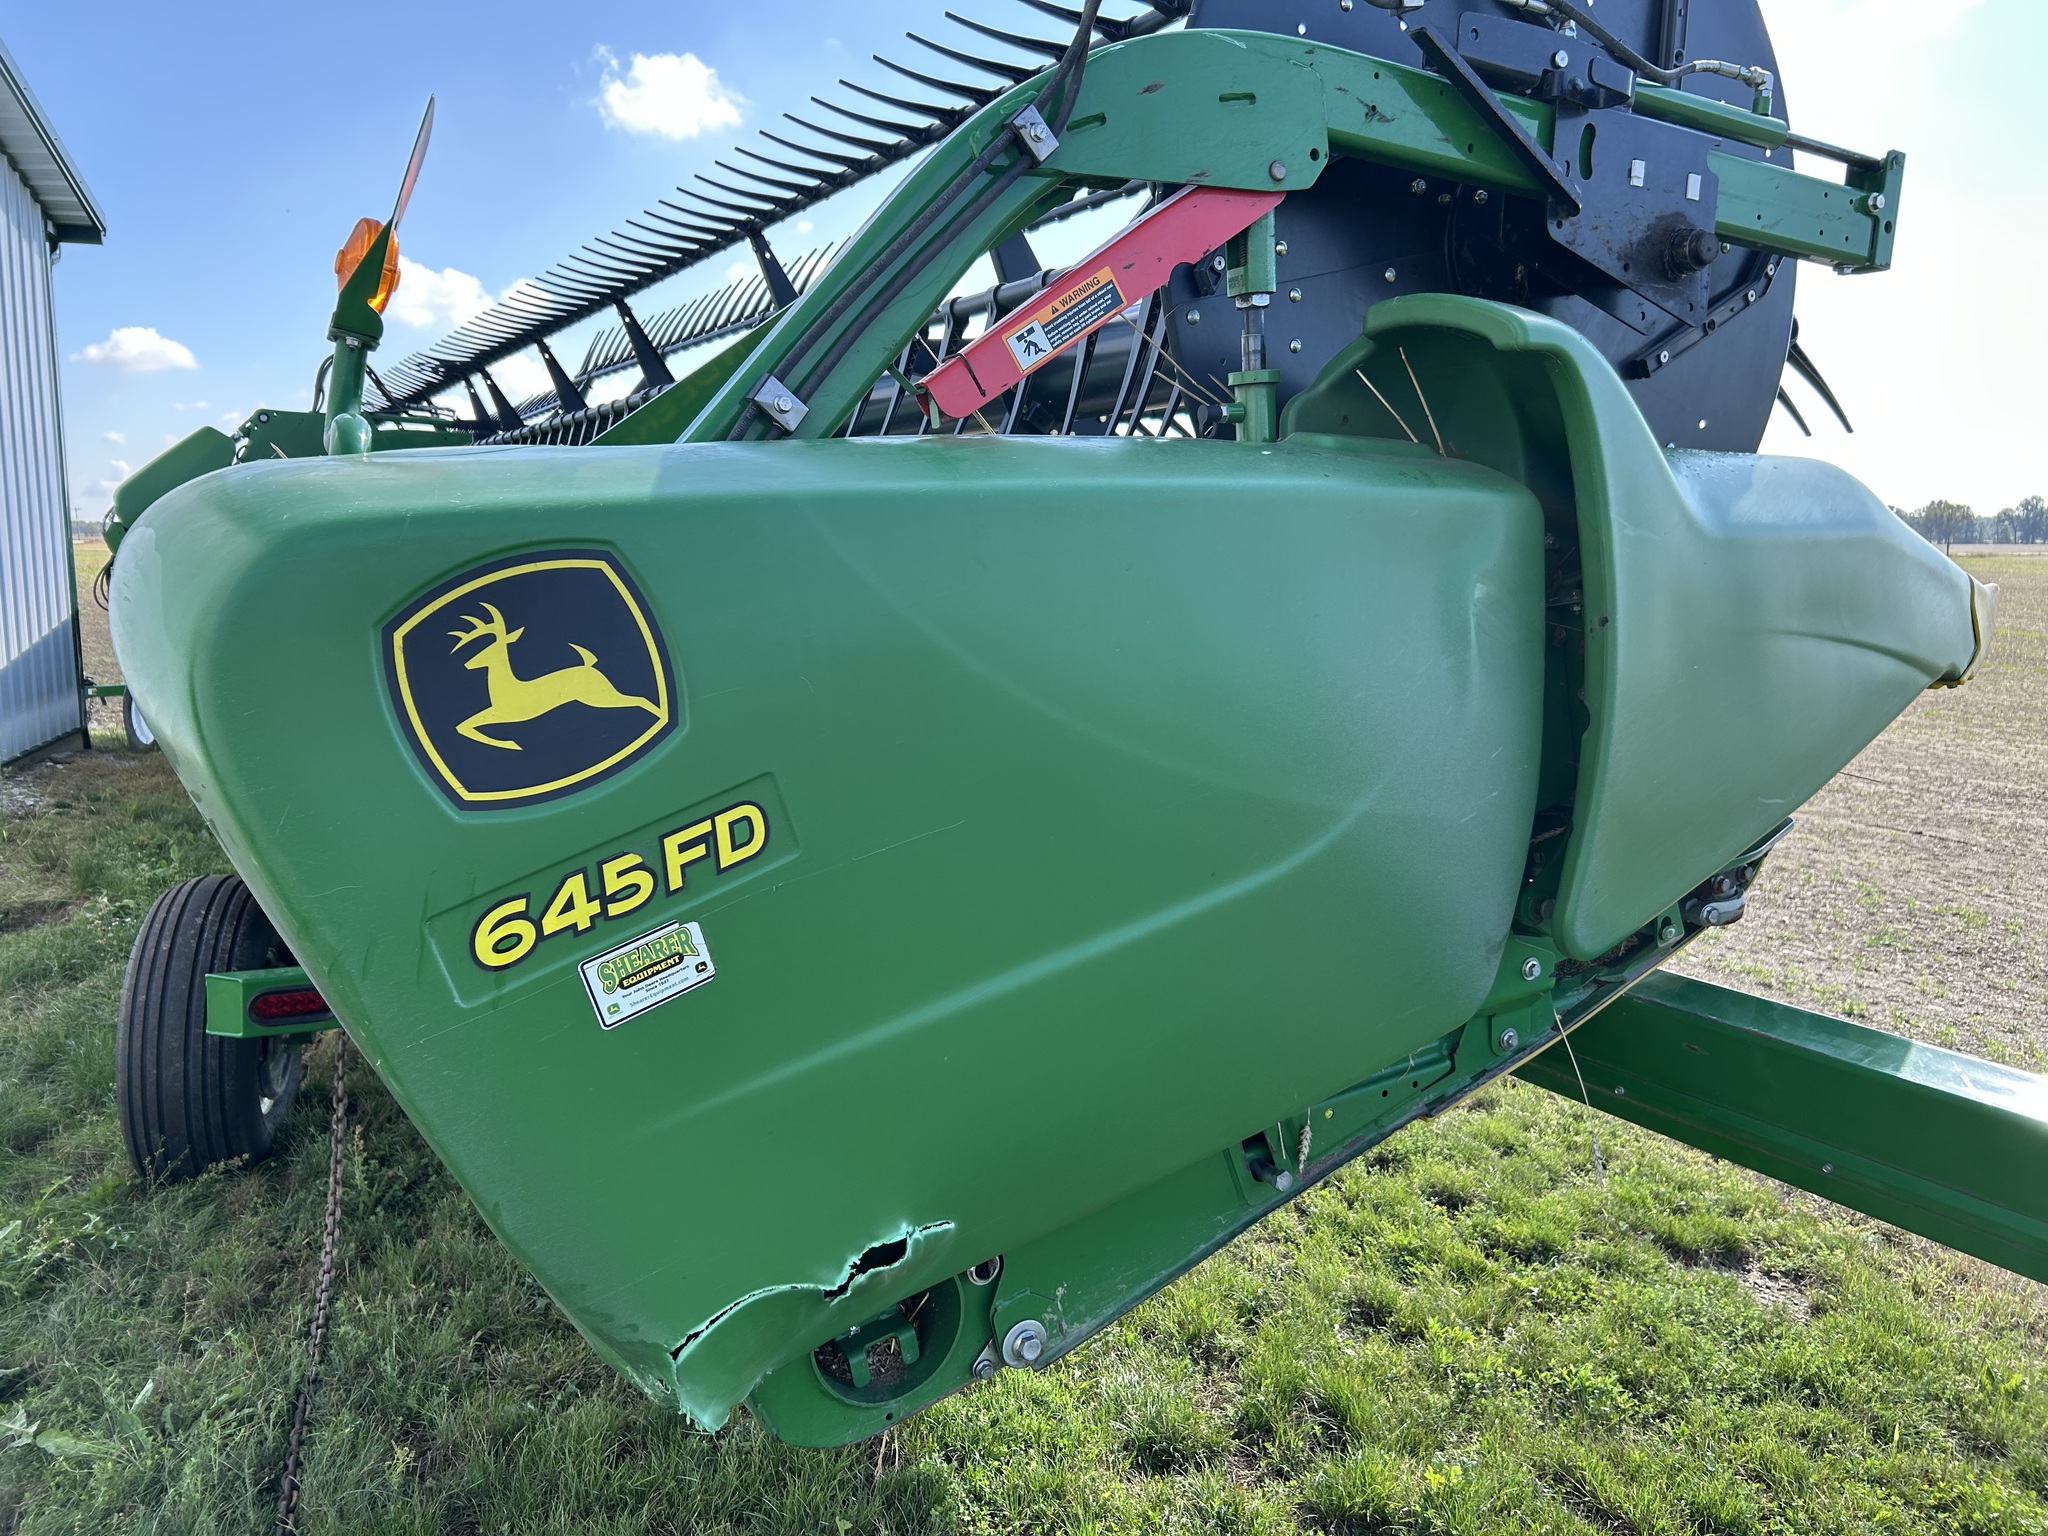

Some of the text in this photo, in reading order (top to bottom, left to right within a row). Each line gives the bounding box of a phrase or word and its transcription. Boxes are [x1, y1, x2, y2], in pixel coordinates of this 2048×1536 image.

[1059, 276, 1101, 308] WARNING
[1044, 324, 1054, 332] Avoid
[1053, 315, 1067, 326] crushing
[1067, 307, 1079, 316] injuries
[1097, 288, 1107, 296] raised
[1048, 330, 1058, 338] Before
[1058, 322, 1071, 331] working
[1087, 303, 1098, 311] raised
[1061, 326, 1073, 335] remove
[1091, 307, 1100, 315] brake
[1086, 315, 1098, 324] cylinder
[598, 928, 699, 994] SHEARER
[622, 955, 681, 987] EQUIPMENT
[630, 977, 689, 1007] ShearerEquipment.com
[633, 986, 644, 994] John
[645, 980, 658, 988] Deere
[659, 965, 689, 984] Headquarters
[646, 984, 658, 993] Since
